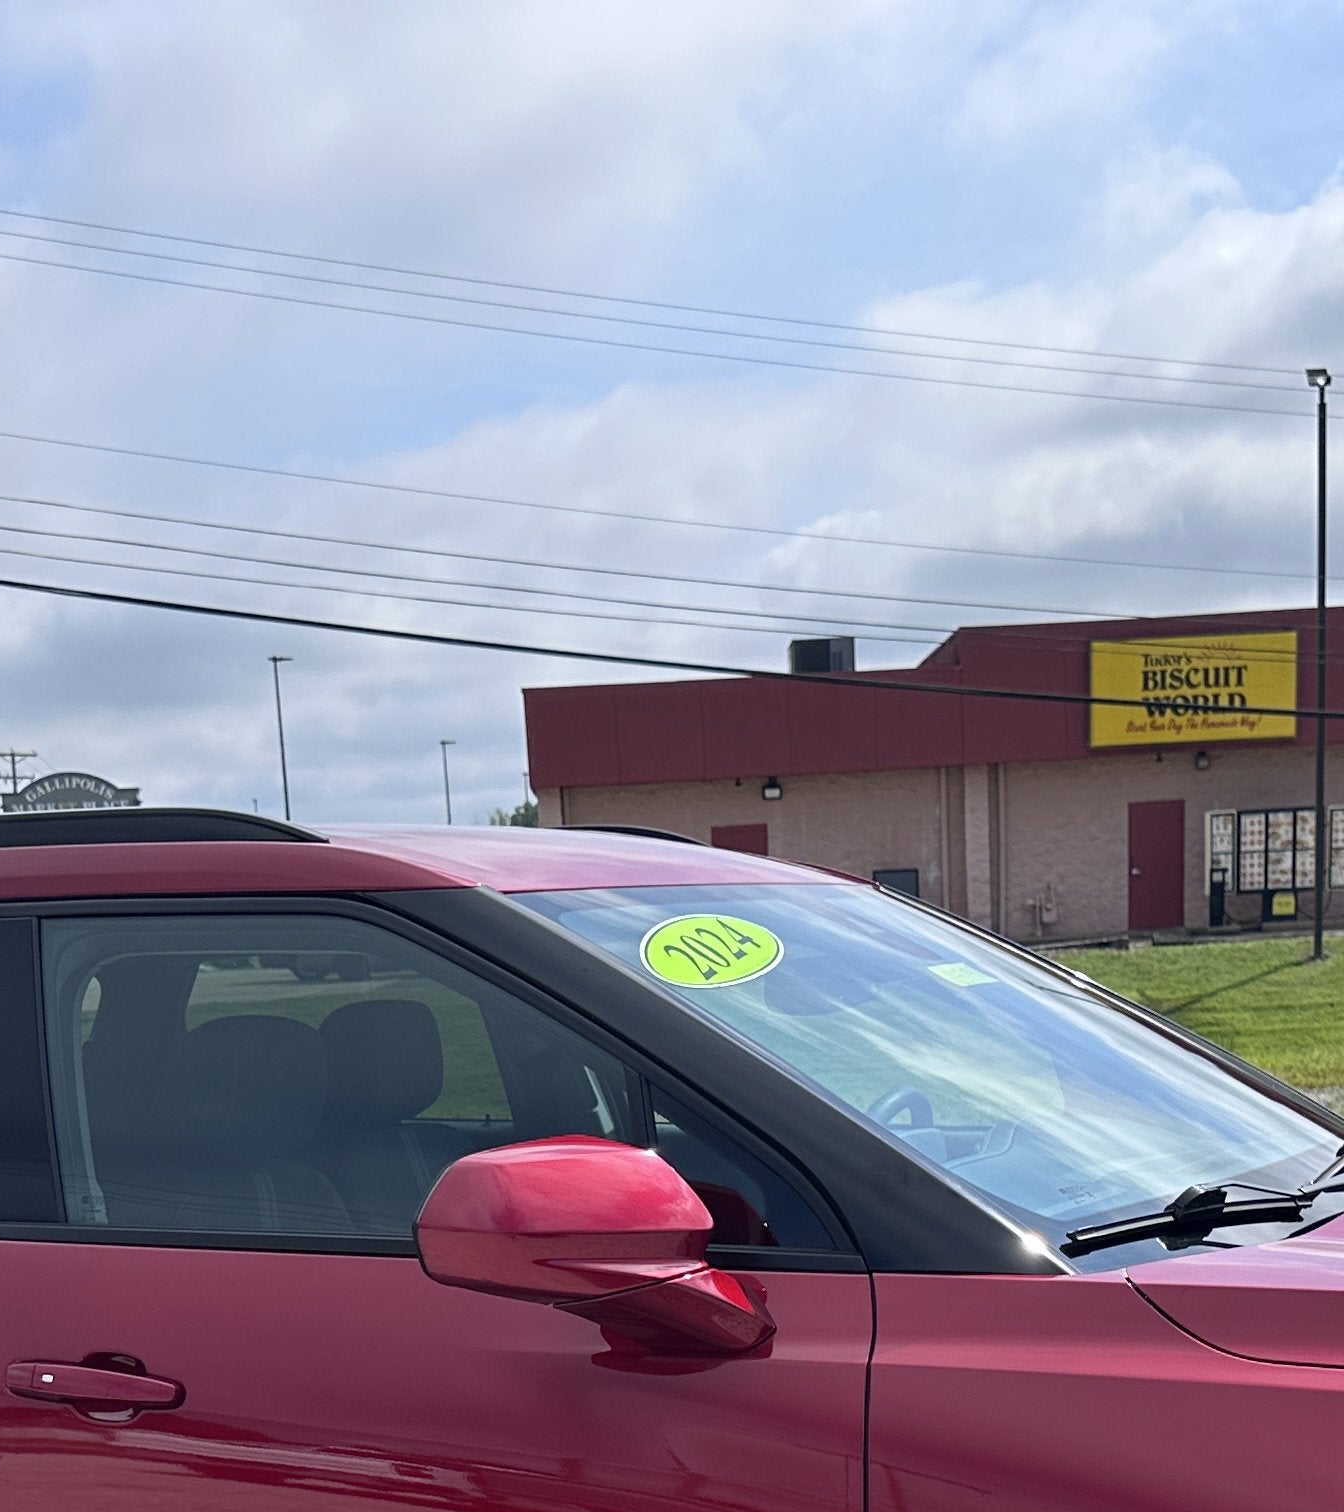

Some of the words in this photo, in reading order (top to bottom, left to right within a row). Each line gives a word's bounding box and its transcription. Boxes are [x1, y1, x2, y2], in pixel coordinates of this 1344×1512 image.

[1142, 652, 1193, 667] Tudor's
[1142, 665, 1248, 692] BISCUIT
[1142, 692, 1248, 718] WORLD
[25, 777, 116, 802] GALLIPOLIS
[664, 918, 761, 981] 2024
